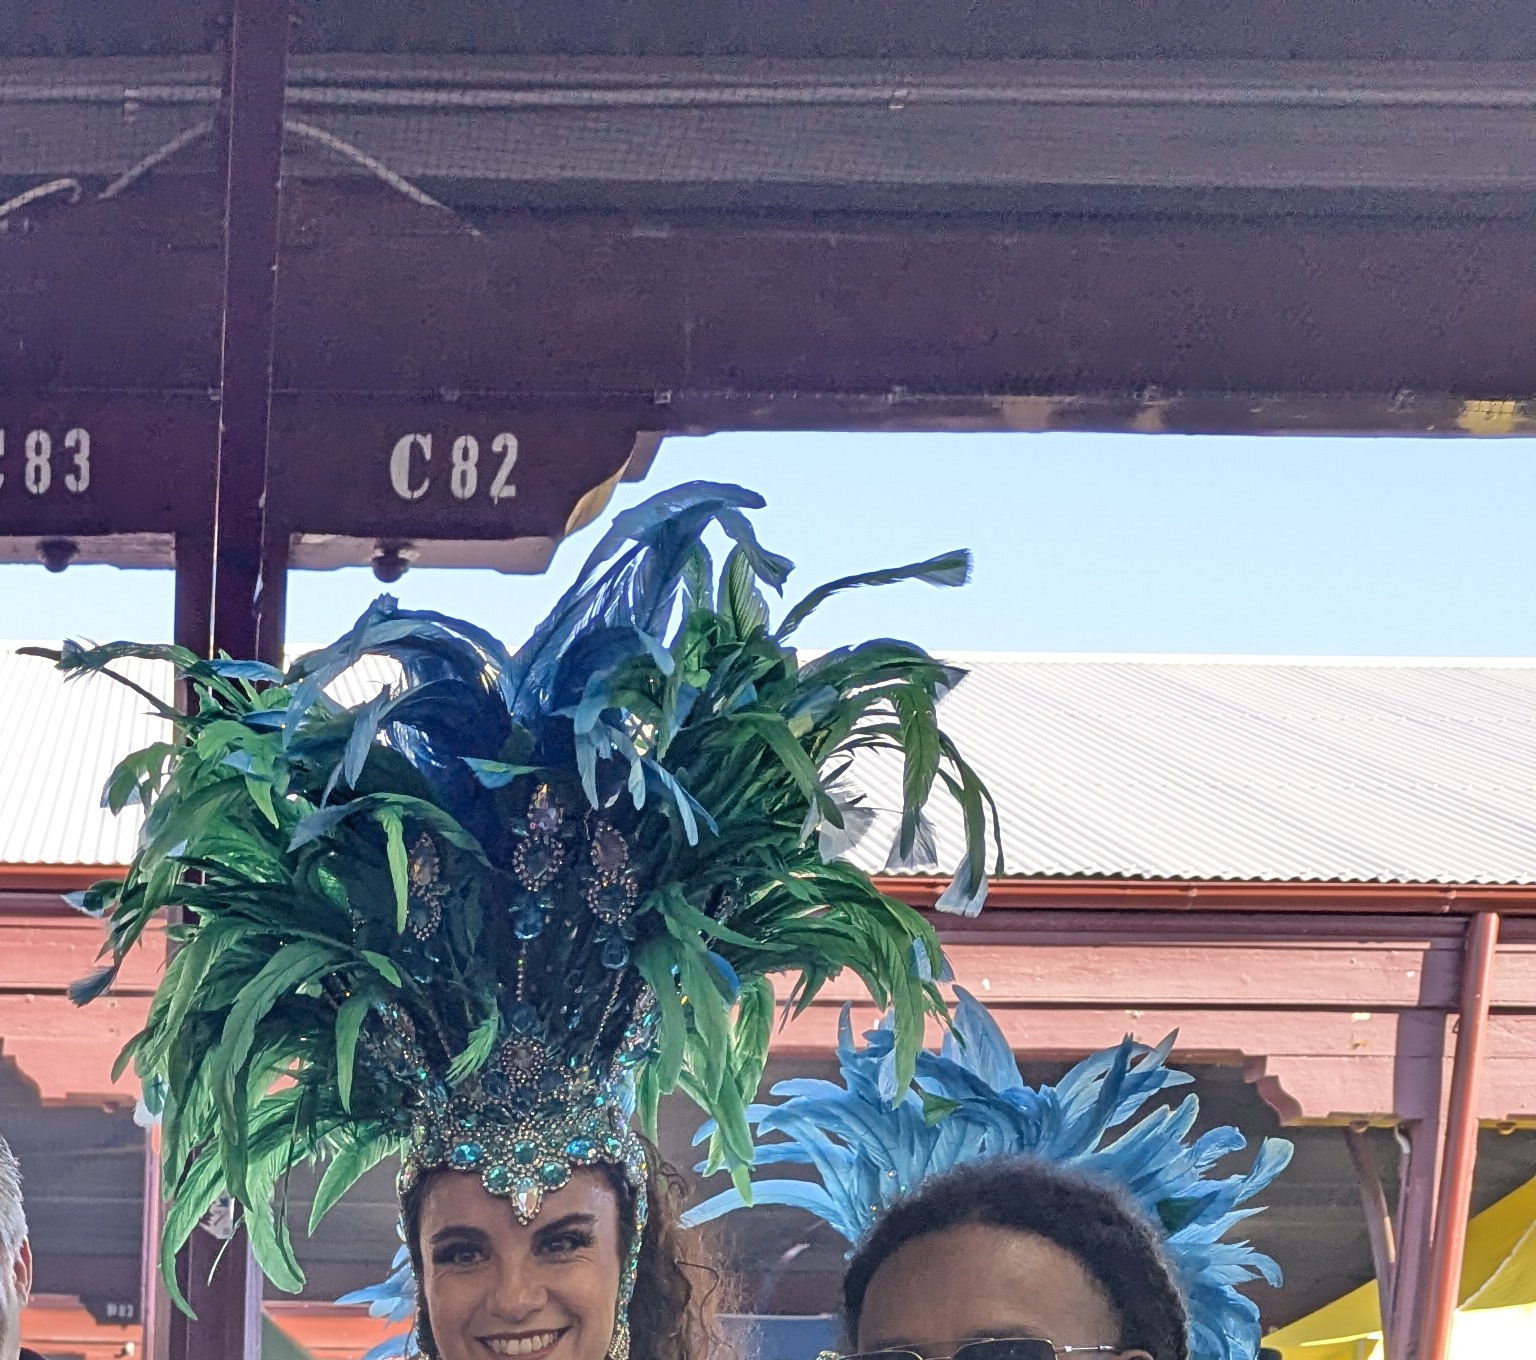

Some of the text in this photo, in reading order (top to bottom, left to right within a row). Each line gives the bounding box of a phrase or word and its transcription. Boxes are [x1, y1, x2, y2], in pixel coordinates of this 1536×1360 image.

[25, 427, 91, 495] 83
[390, 432, 518, 500] C 82
